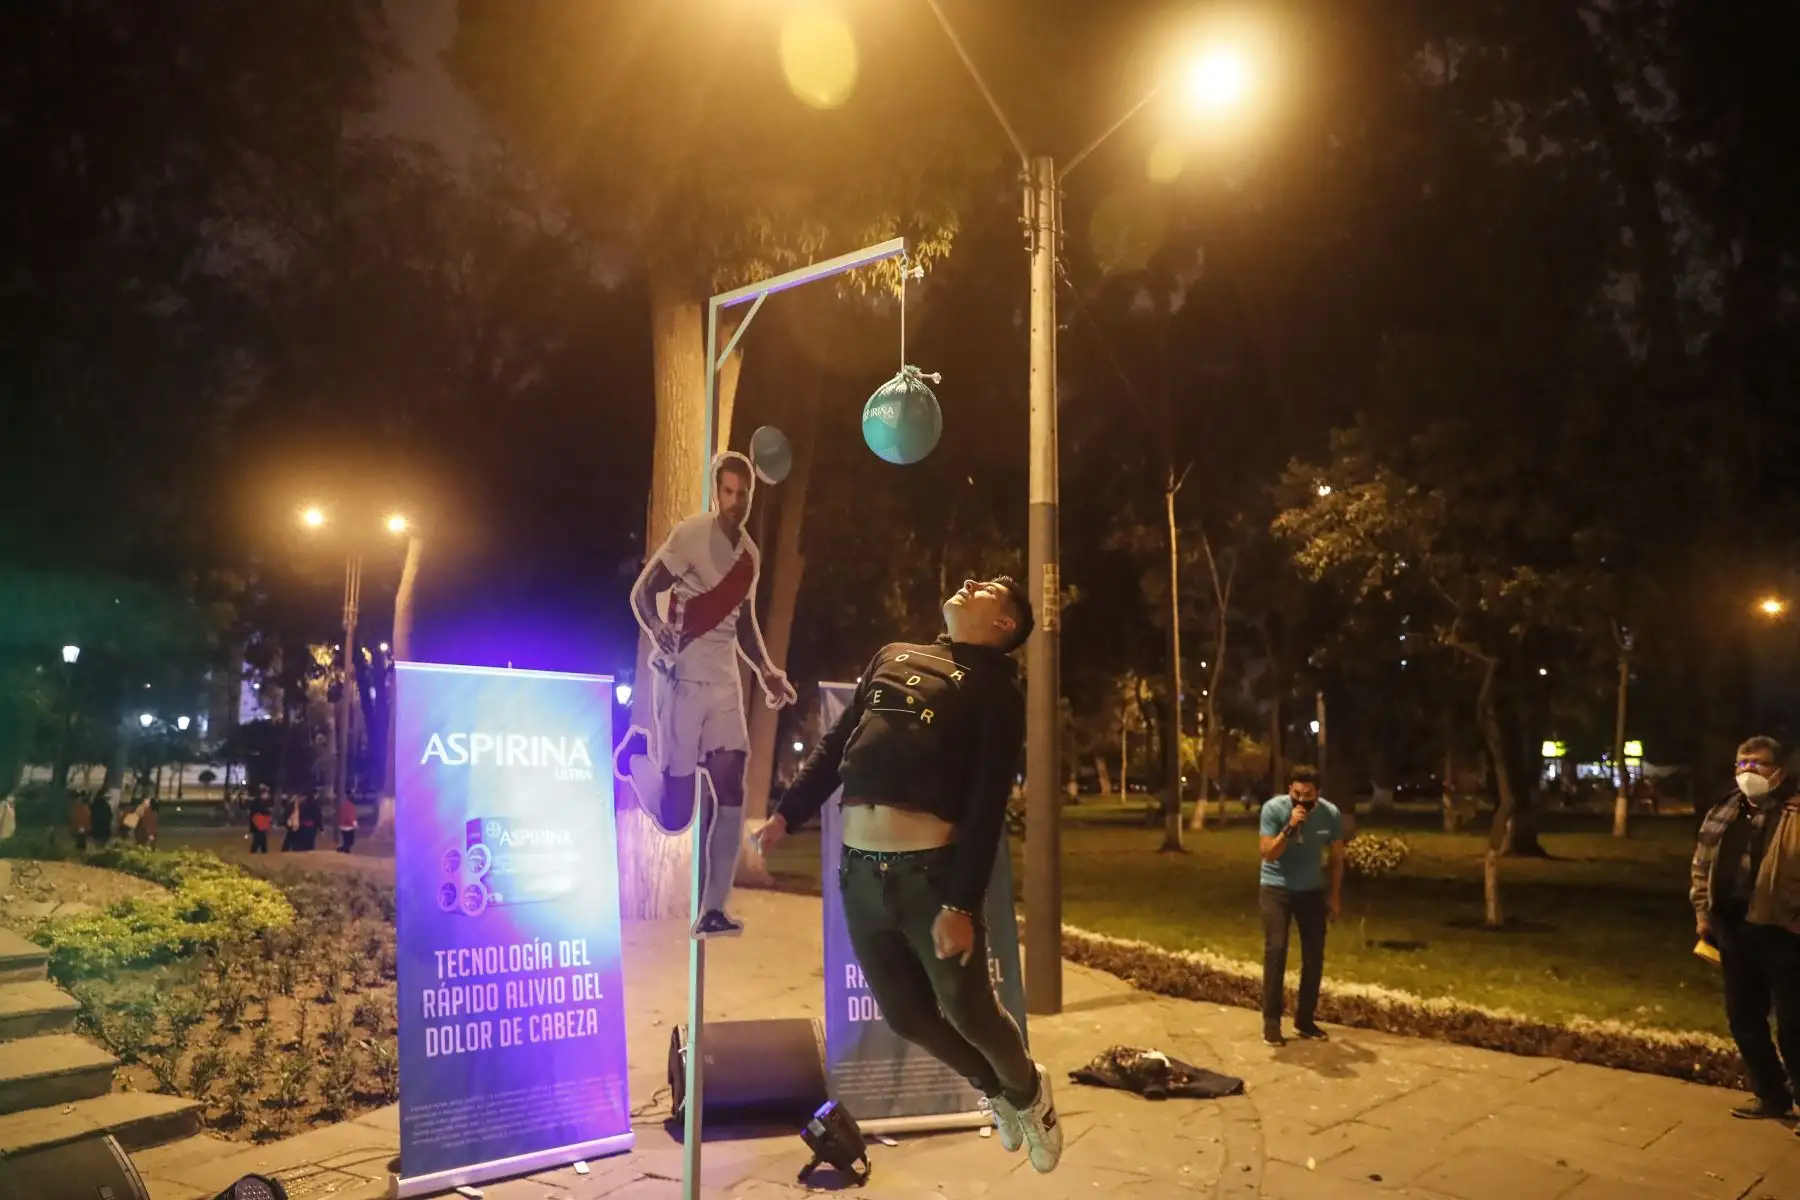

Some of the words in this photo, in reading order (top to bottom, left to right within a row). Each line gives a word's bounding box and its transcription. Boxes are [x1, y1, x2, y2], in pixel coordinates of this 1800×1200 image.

[420, 732, 592, 767] ASPIRINA
[499, 829, 573, 847] ASPIRINA
[434, 937, 553, 979] TECNOLOGÍA
[558, 938, 591, 967] DEL
[423, 981, 498, 1018] RÁPIDO
[505, 976, 566, 1010] ALIVIO
[571, 973, 603, 1001] DEL
[848, 996, 883, 1021] DOL
[425, 1020, 492, 1057] DOLOR
[500, 1017, 523, 1047] DE
[529, 1008, 599, 1044] CABEZA
